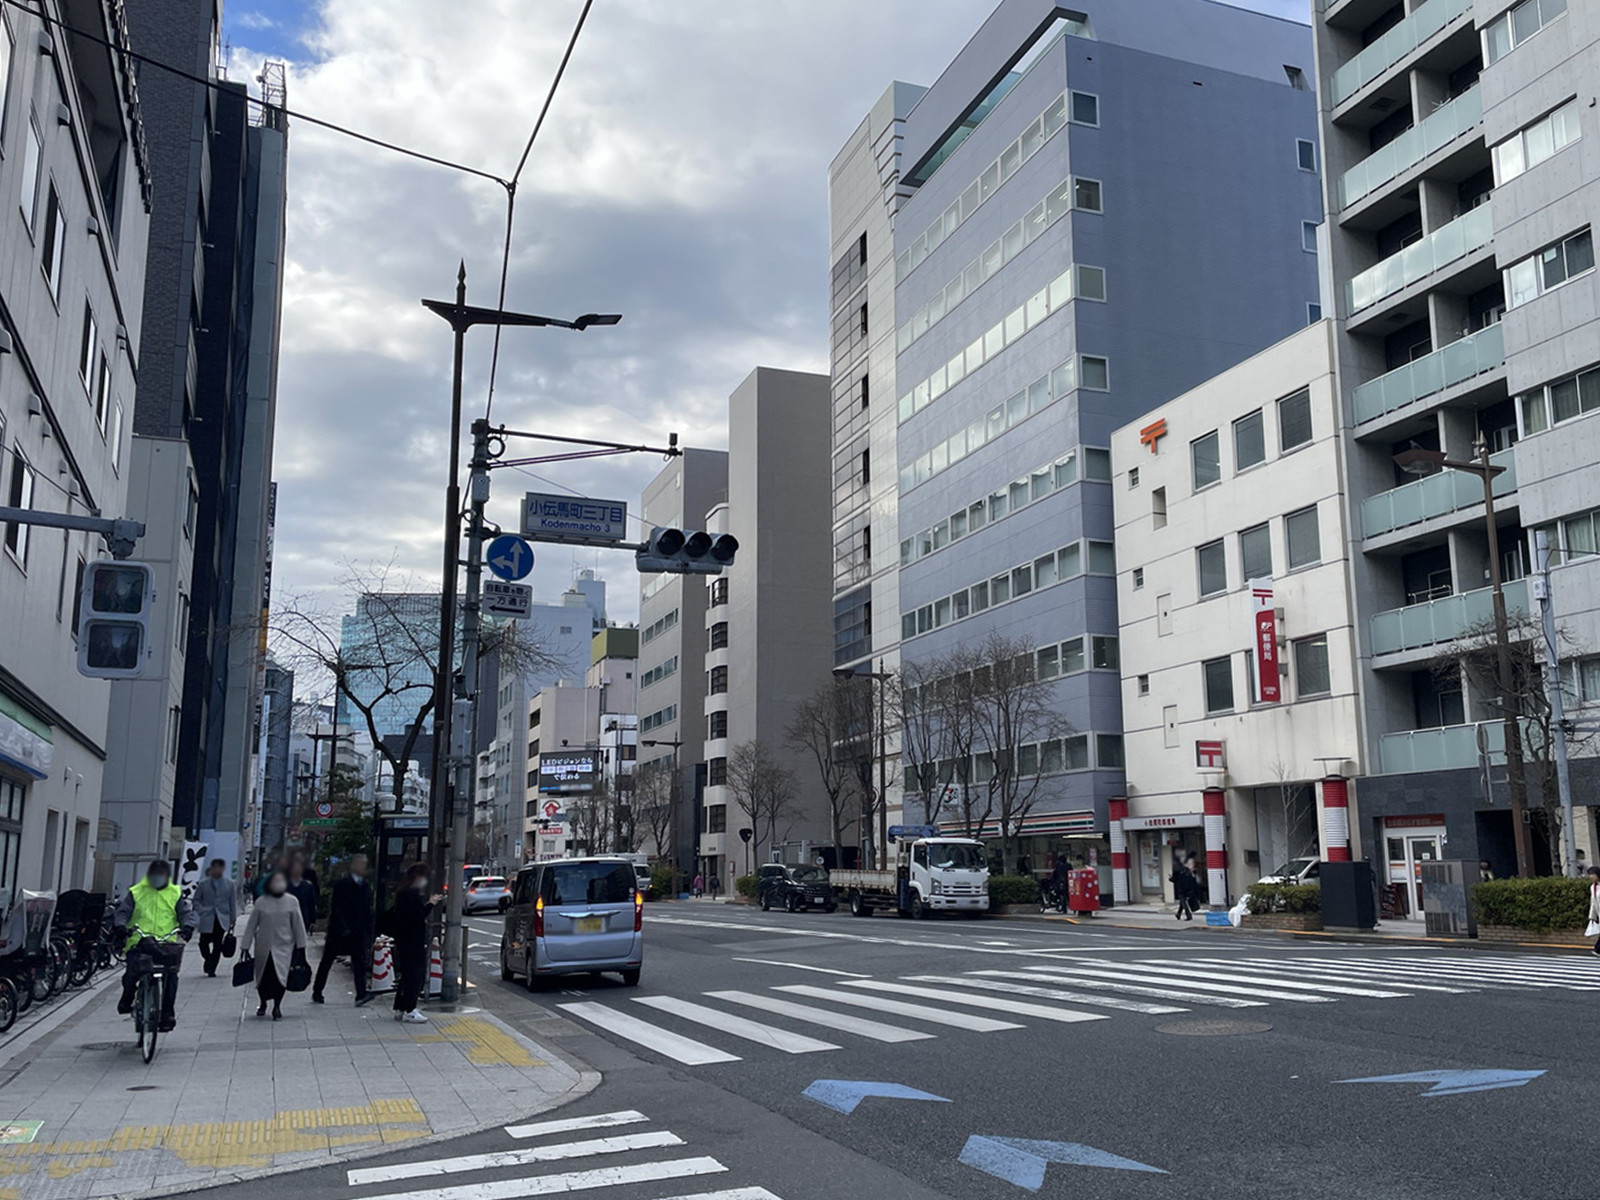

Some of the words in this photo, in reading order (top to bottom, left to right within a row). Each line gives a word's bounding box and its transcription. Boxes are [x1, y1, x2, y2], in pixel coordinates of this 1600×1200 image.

[529, 500, 622, 522] 小伝馬町三丁目
[541, 518, 601, 532] Kodenmacho
[604, 524, 611, 533] 3
[486, 596, 528, 607] 一方通行
